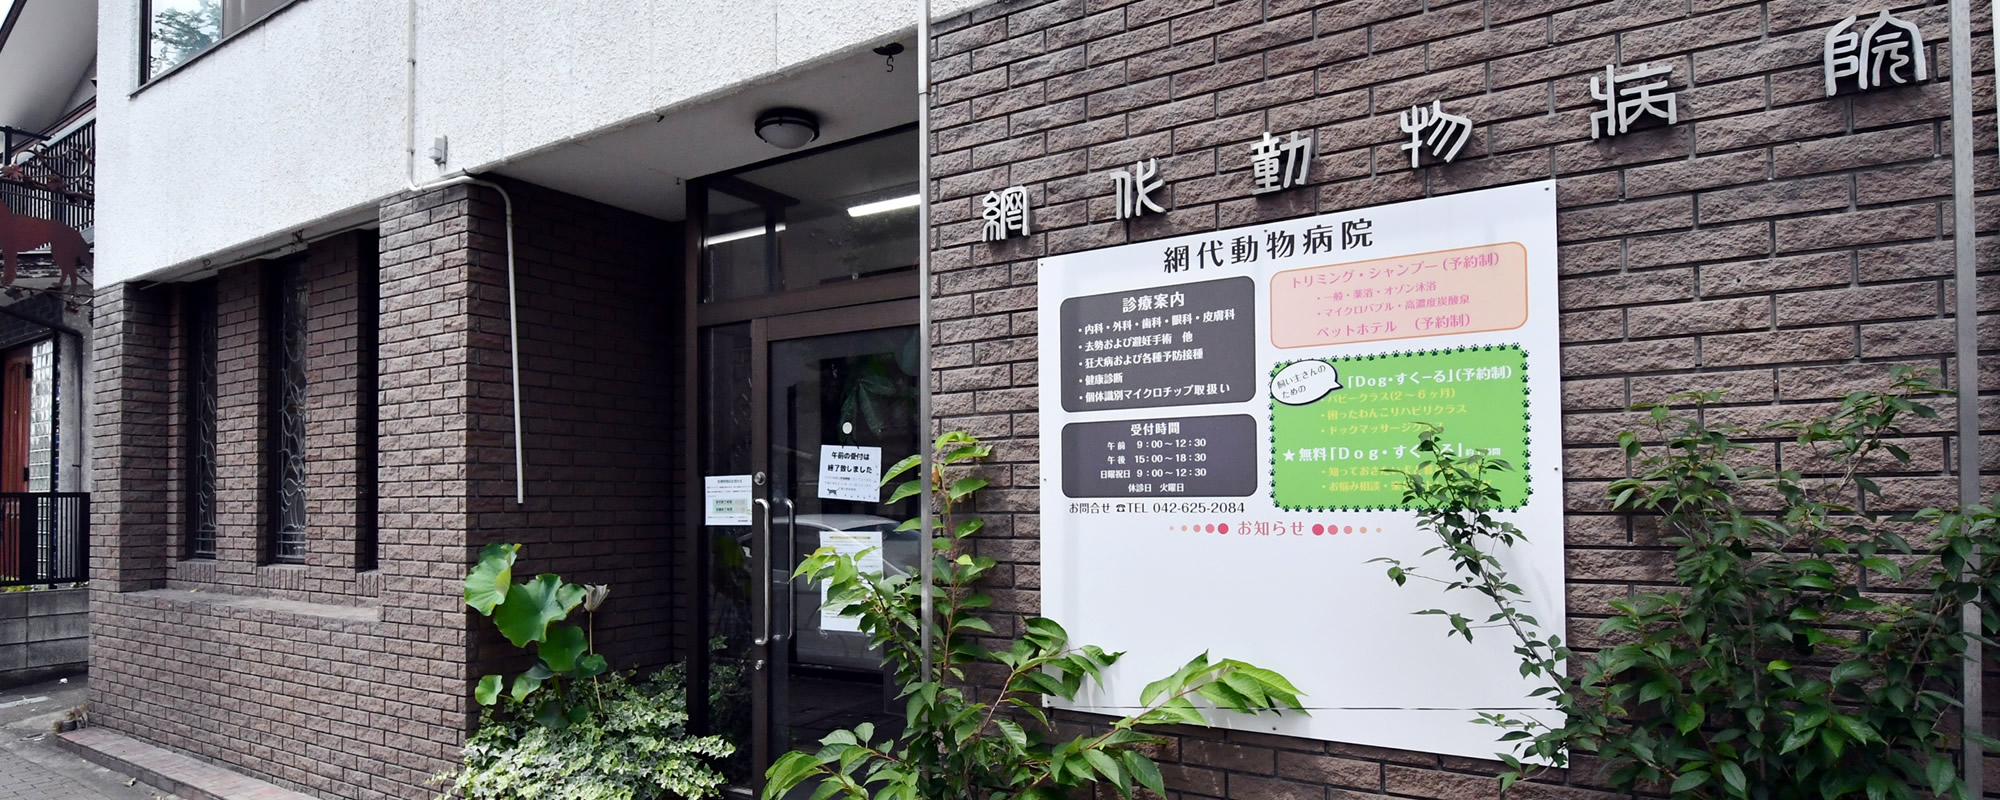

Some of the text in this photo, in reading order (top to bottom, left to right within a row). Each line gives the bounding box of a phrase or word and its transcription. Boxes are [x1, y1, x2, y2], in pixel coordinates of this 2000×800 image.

[1163, 216, 1375, 273] 網代動物病院
[1122, 291, 1185, 313] 診療案内
[1414, 313, 1471, 331] (予約制)
[1182, 331, 1193, 343] 他
[1276, 365, 1327, 389] 飼い主さんの
[1282, 385, 1307, 399] ための
[1130, 422, 1180, 436] 受付時間
[1107, 441, 1126, 451] 午前
[831, 451, 870, 461] 午前の受付は
[1107, 456, 1126, 465] 午後
[827, 464, 873, 474] 終了致しました
[1100, 470, 1131, 479] 日曜祝日
[1128, 483, 1184, 493] 休診日 火曜日
[1068, 503, 1110, 514] お問合せ
[1152, 502, 1245, 514] 042-625-2084
[1237, 520, 1304, 536] お知らせ
